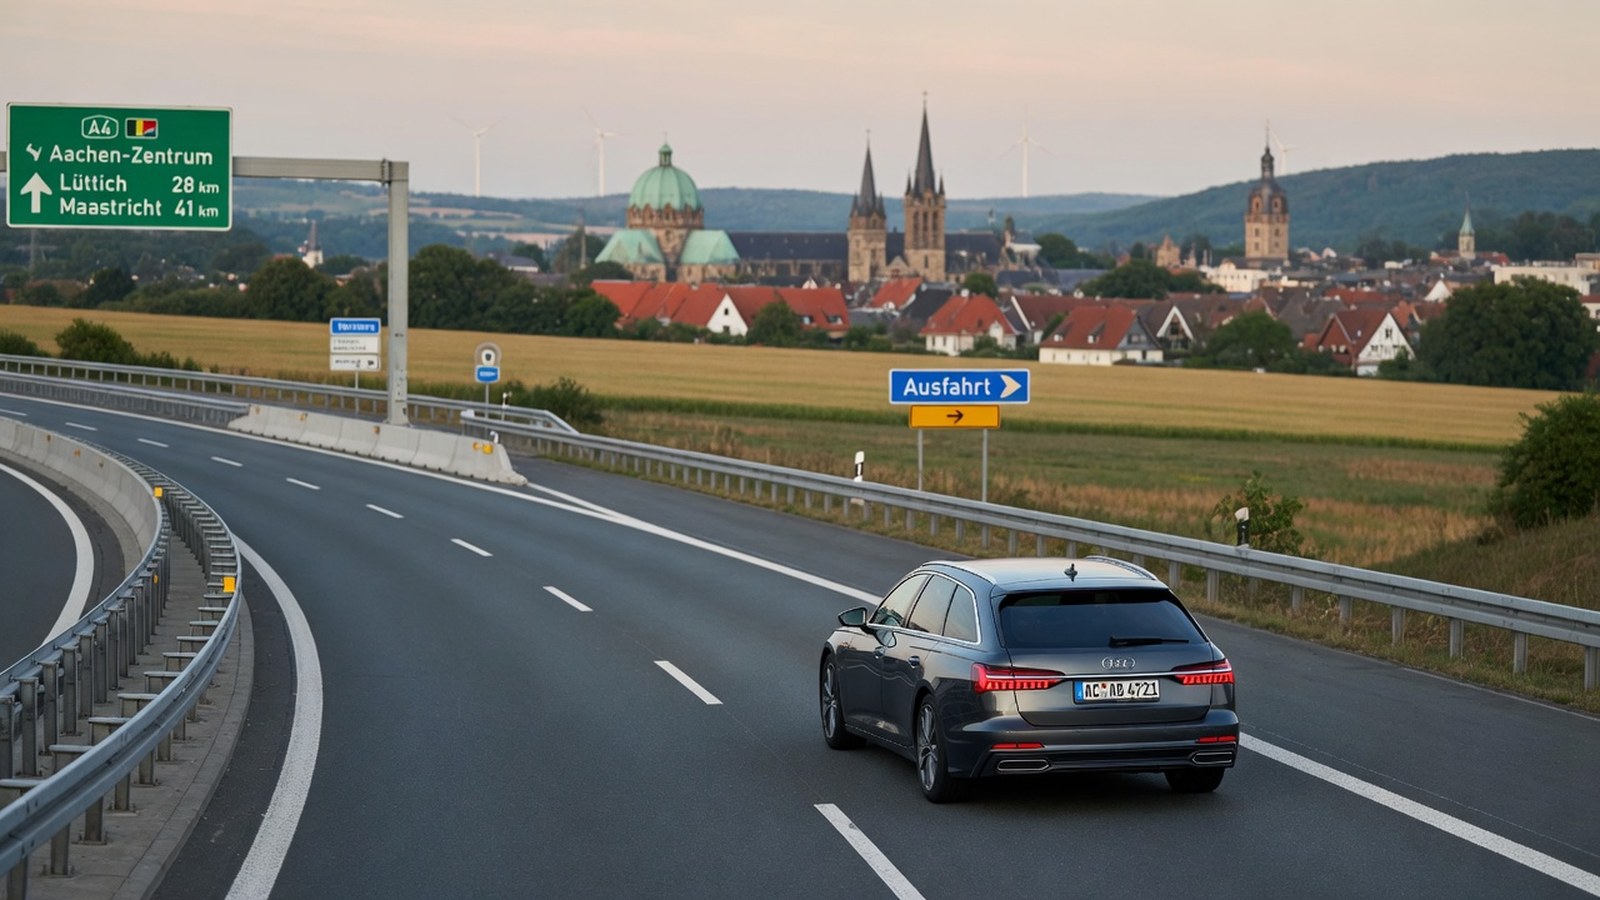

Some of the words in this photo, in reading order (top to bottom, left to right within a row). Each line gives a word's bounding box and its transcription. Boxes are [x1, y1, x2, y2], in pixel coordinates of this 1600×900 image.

[88, 119, 111, 136] A4
[49, 144, 213, 165] Aachen-Zentrum
[60, 173, 127, 192] Lüttich
[172, 176, 194, 193] 28
[198, 181, 219, 194] km
[60, 197, 162, 216] Maastricht
[174, 200, 193, 216] 41
[198, 205, 218, 217] km
[903, 376, 991, 396] Ausfahrt
